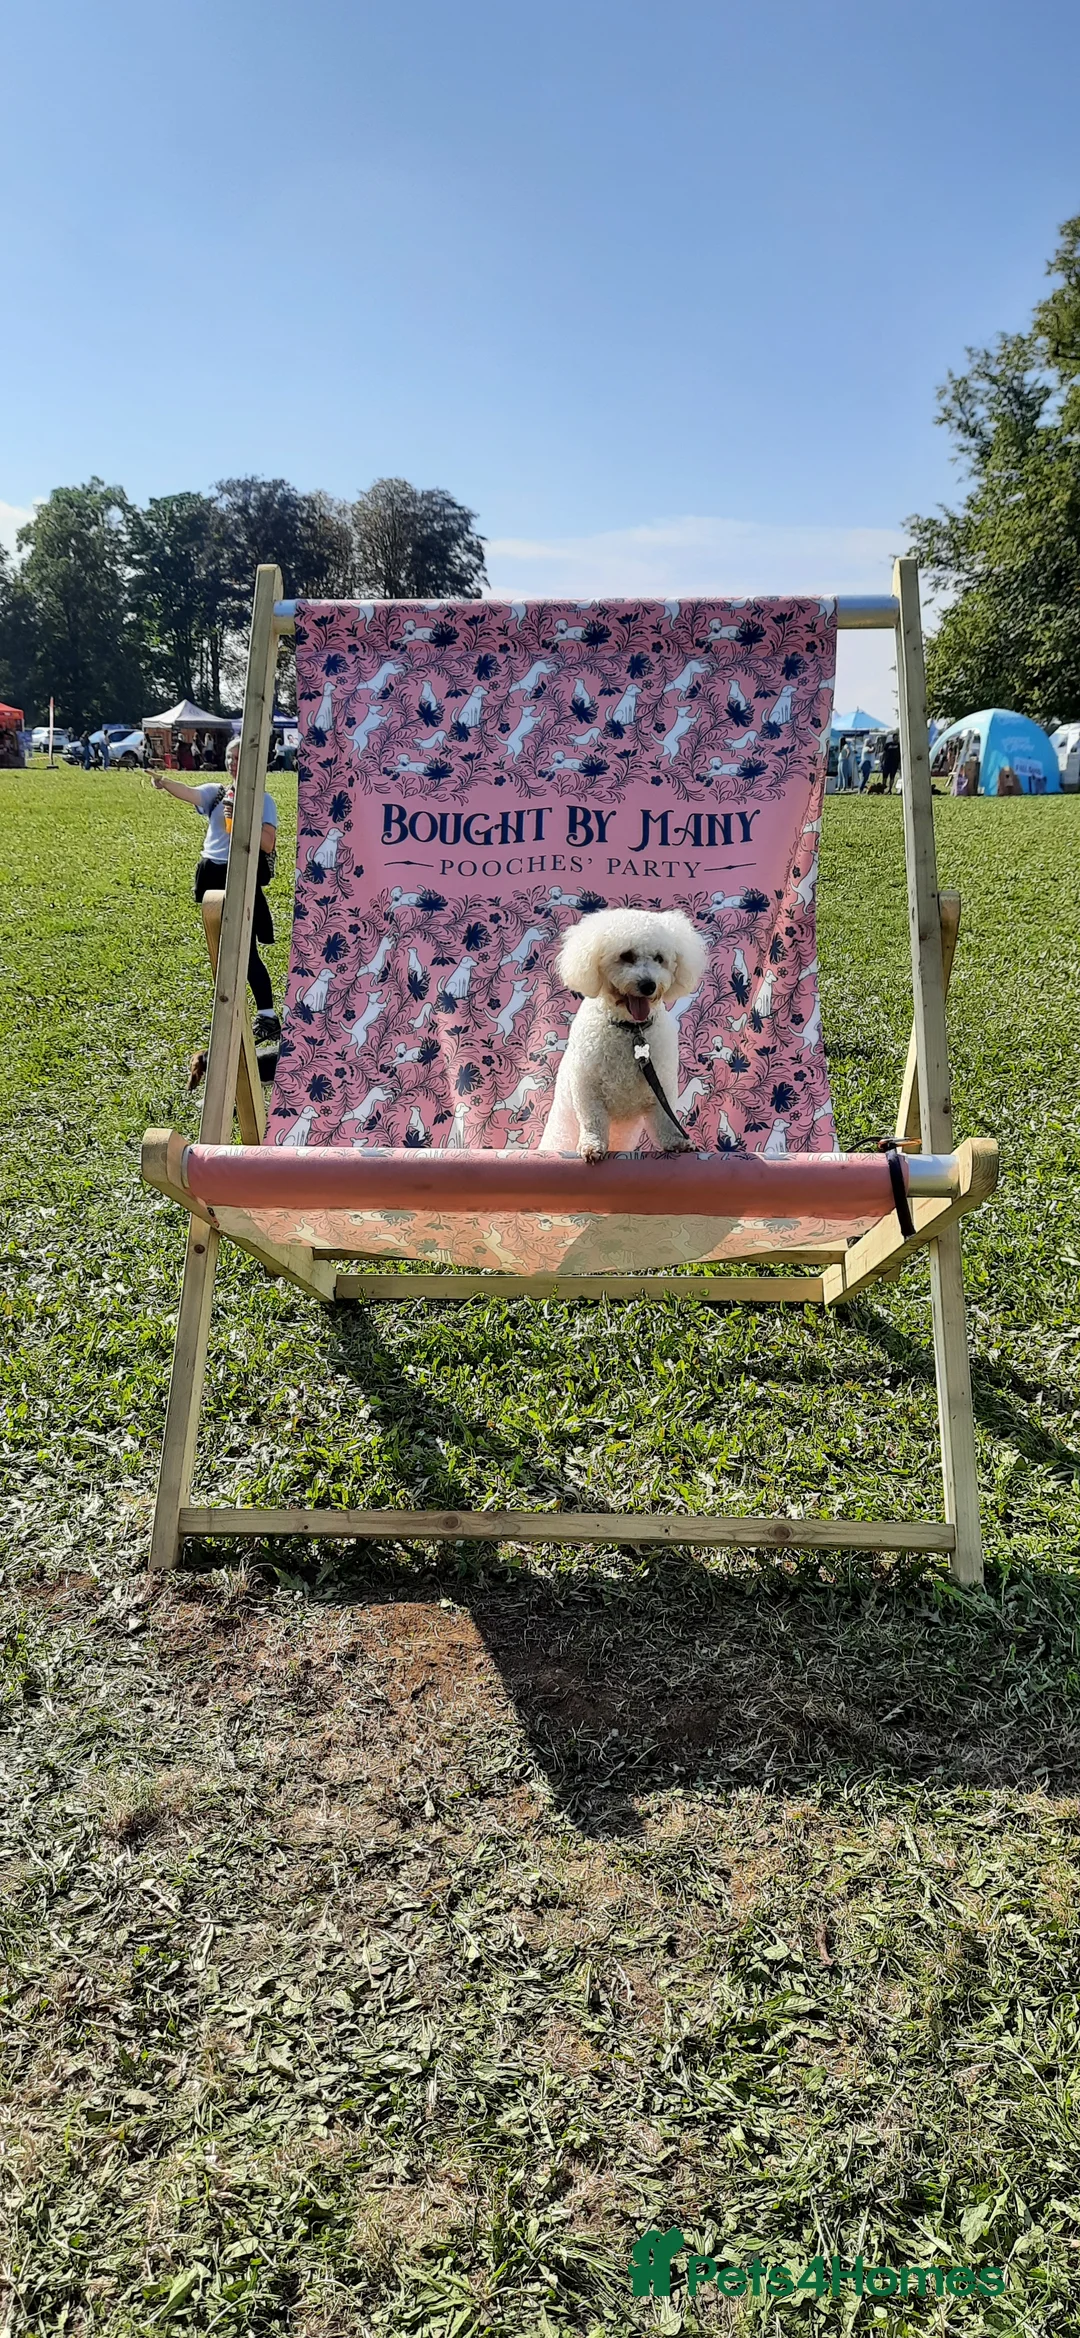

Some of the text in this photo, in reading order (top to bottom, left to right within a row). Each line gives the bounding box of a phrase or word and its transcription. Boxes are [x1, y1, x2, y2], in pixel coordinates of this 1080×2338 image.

[381, 803, 761, 852] BOUGHT BY MANY
[606, 857, 702, 878] PARTY
